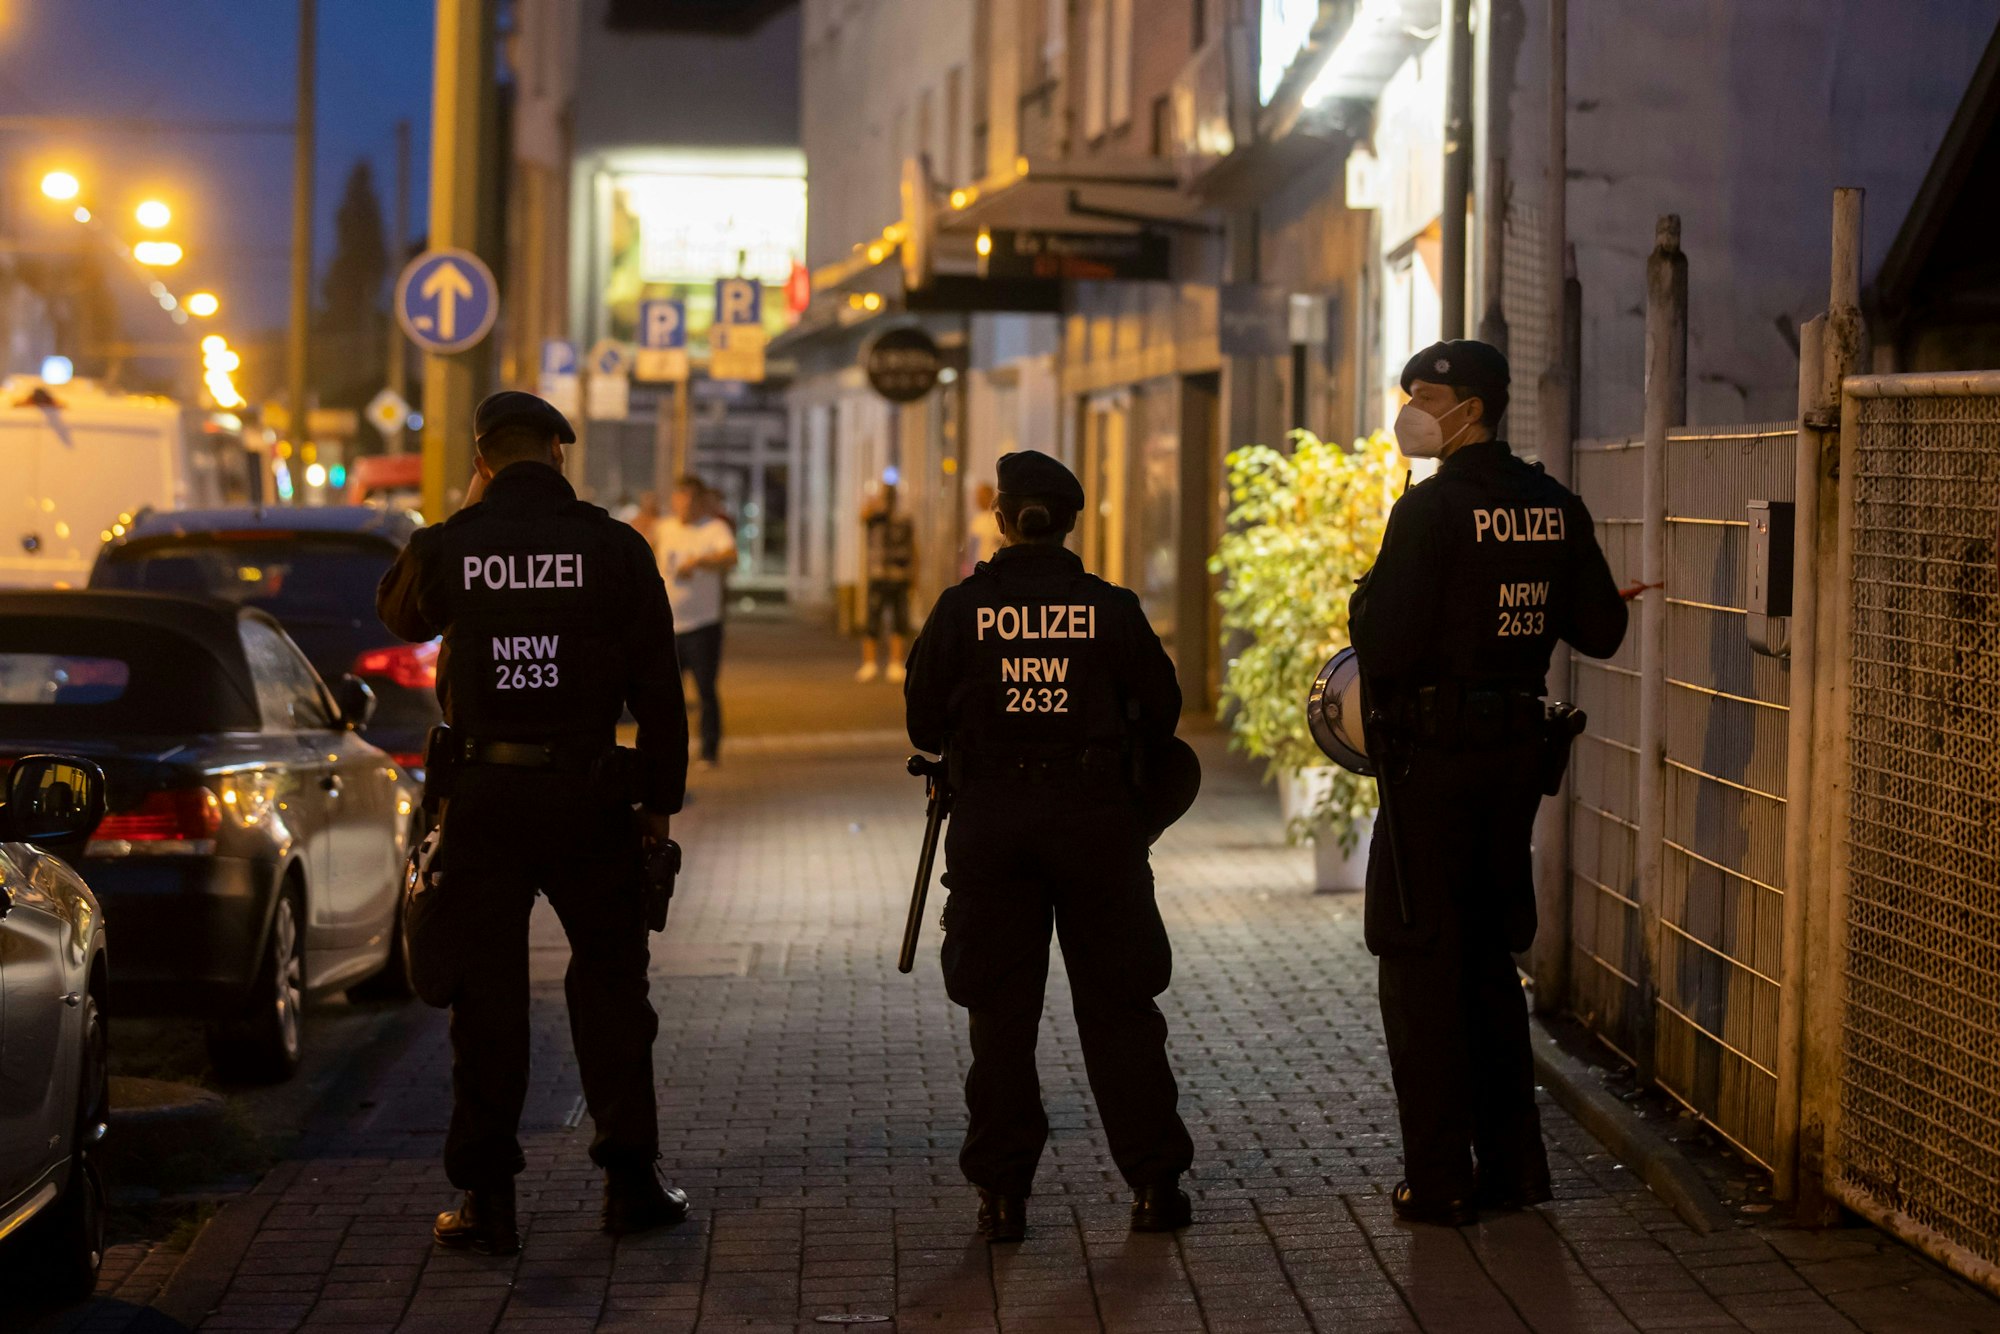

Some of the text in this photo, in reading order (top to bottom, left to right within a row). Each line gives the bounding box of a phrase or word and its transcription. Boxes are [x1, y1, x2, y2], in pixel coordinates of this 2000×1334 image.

[647, 304, 678, 347] P
[1473, 508, 1564, 542] POLIZEI
[464, 554, 583, 590] POLIZEI
[1499, 582, 1549, 607] NRW
[977, 605, 1095, 640] POLIZEI
[1498, 612, 1544, 636] 2633
[493, 635, 559, 660] NRW
[496, 663, 558, 689] 2633
[1002, 658, 1069, 682] NRW
[1006, 688, 1068, 712] 2632
